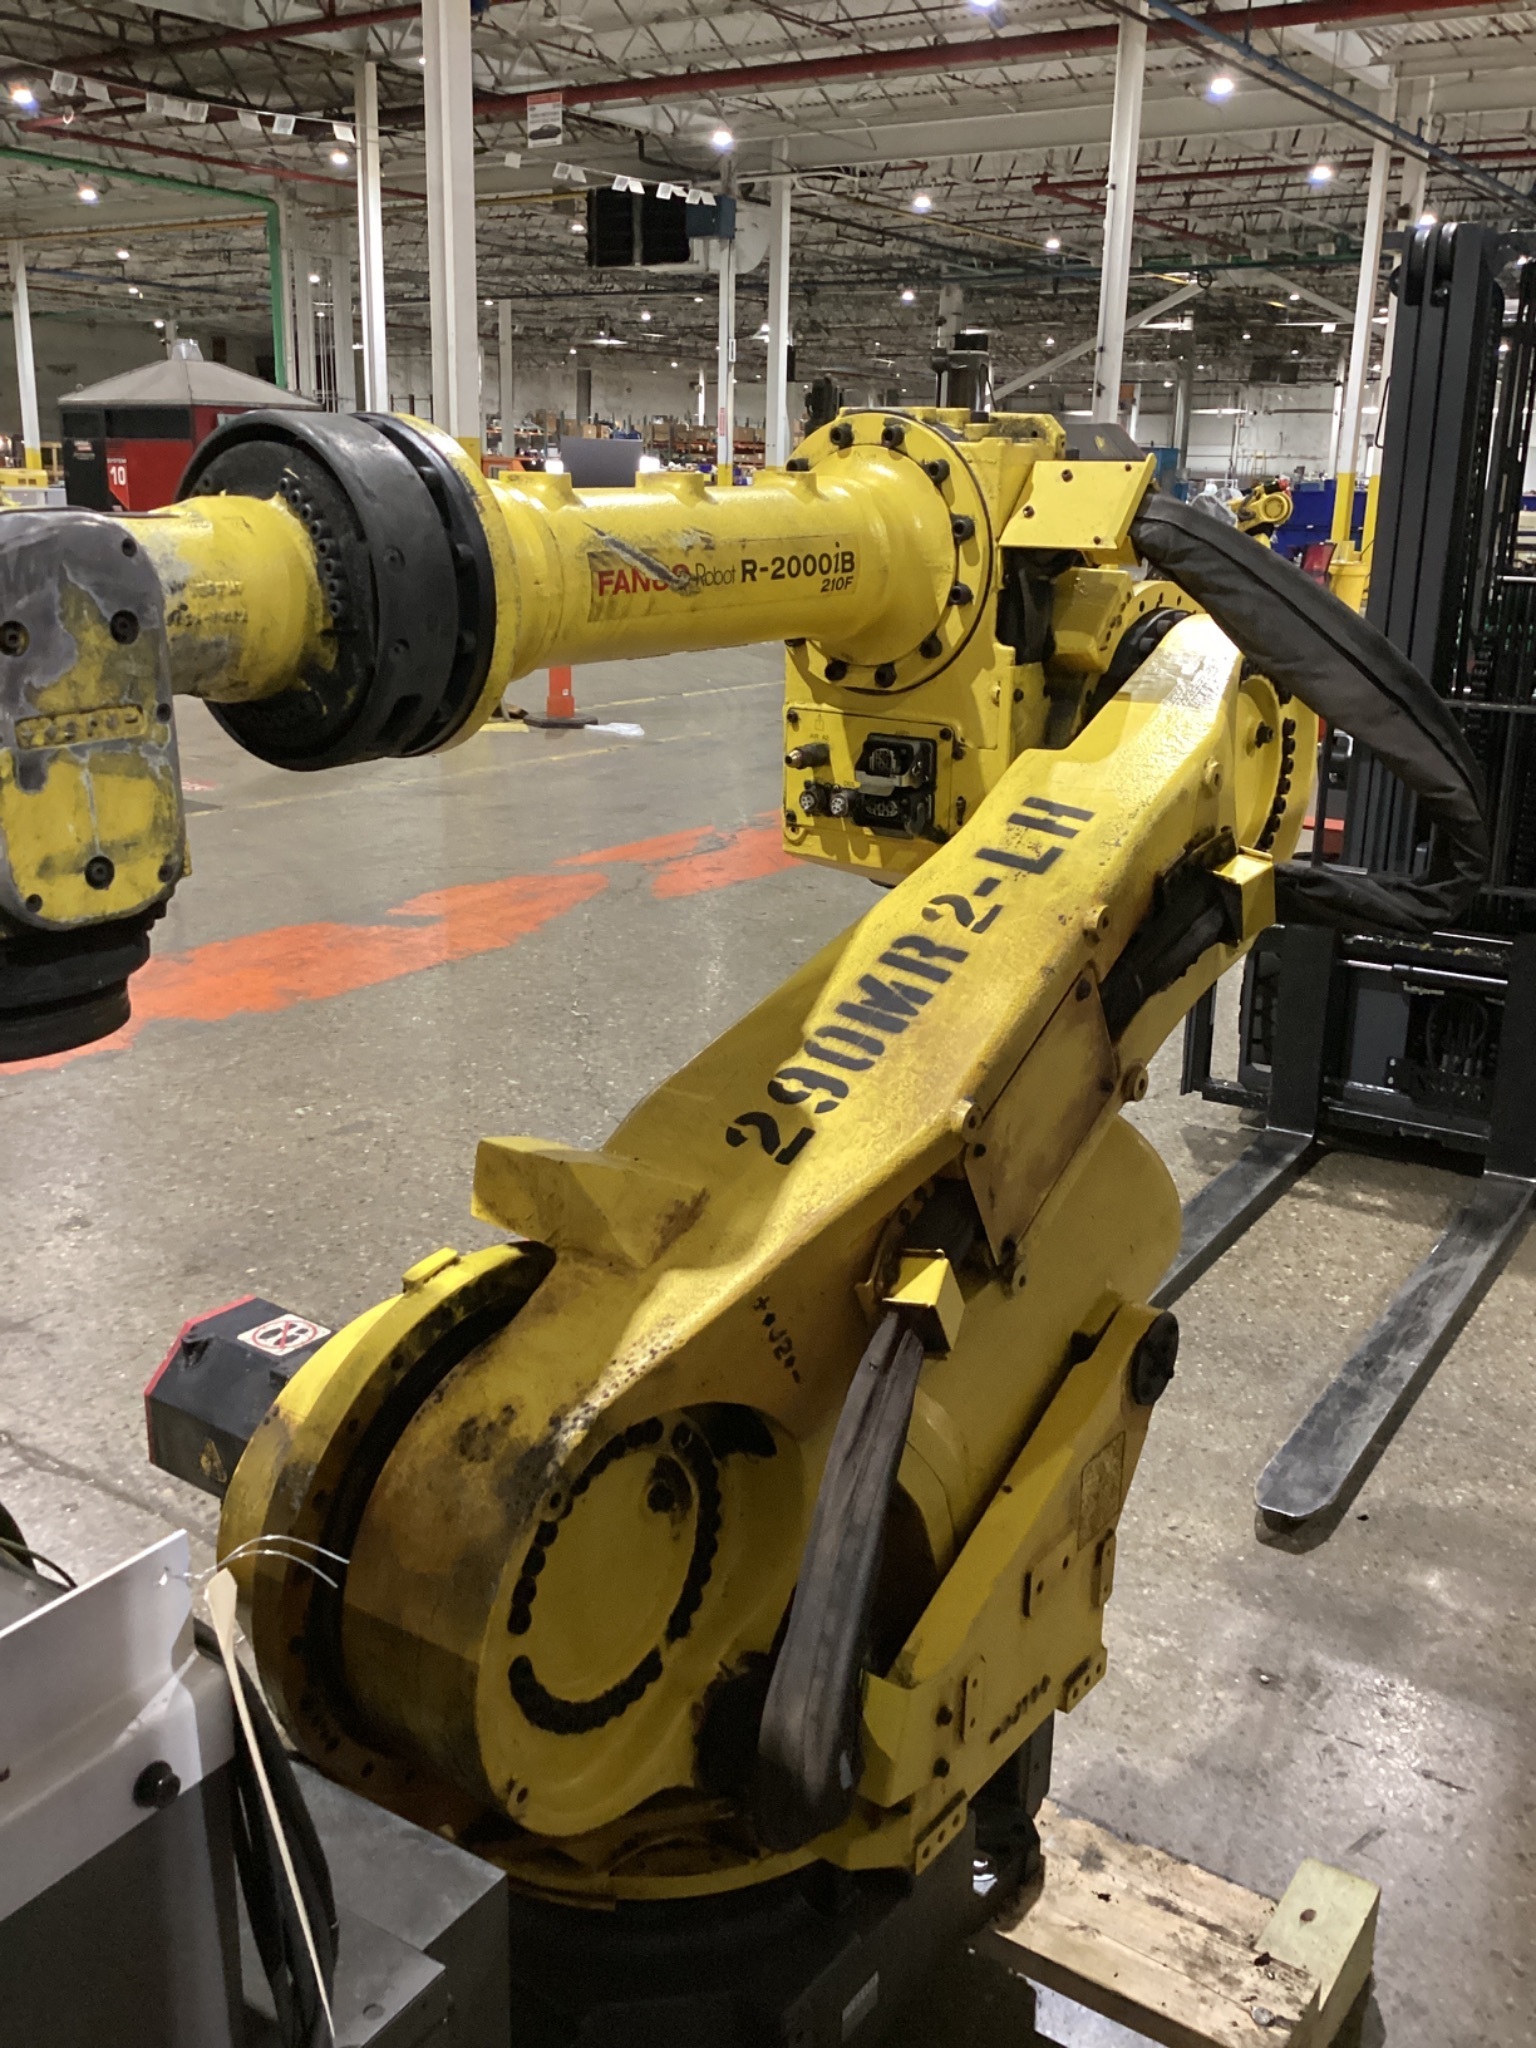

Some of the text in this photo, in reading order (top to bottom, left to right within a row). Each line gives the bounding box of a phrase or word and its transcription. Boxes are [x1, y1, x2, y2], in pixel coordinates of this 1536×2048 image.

[110, 465, 127, 486] 10
[695, 563, 736, 587] Robot
[741, 541, 855, 583] R-2000iB
[820, 577, 853, 593] 210F
